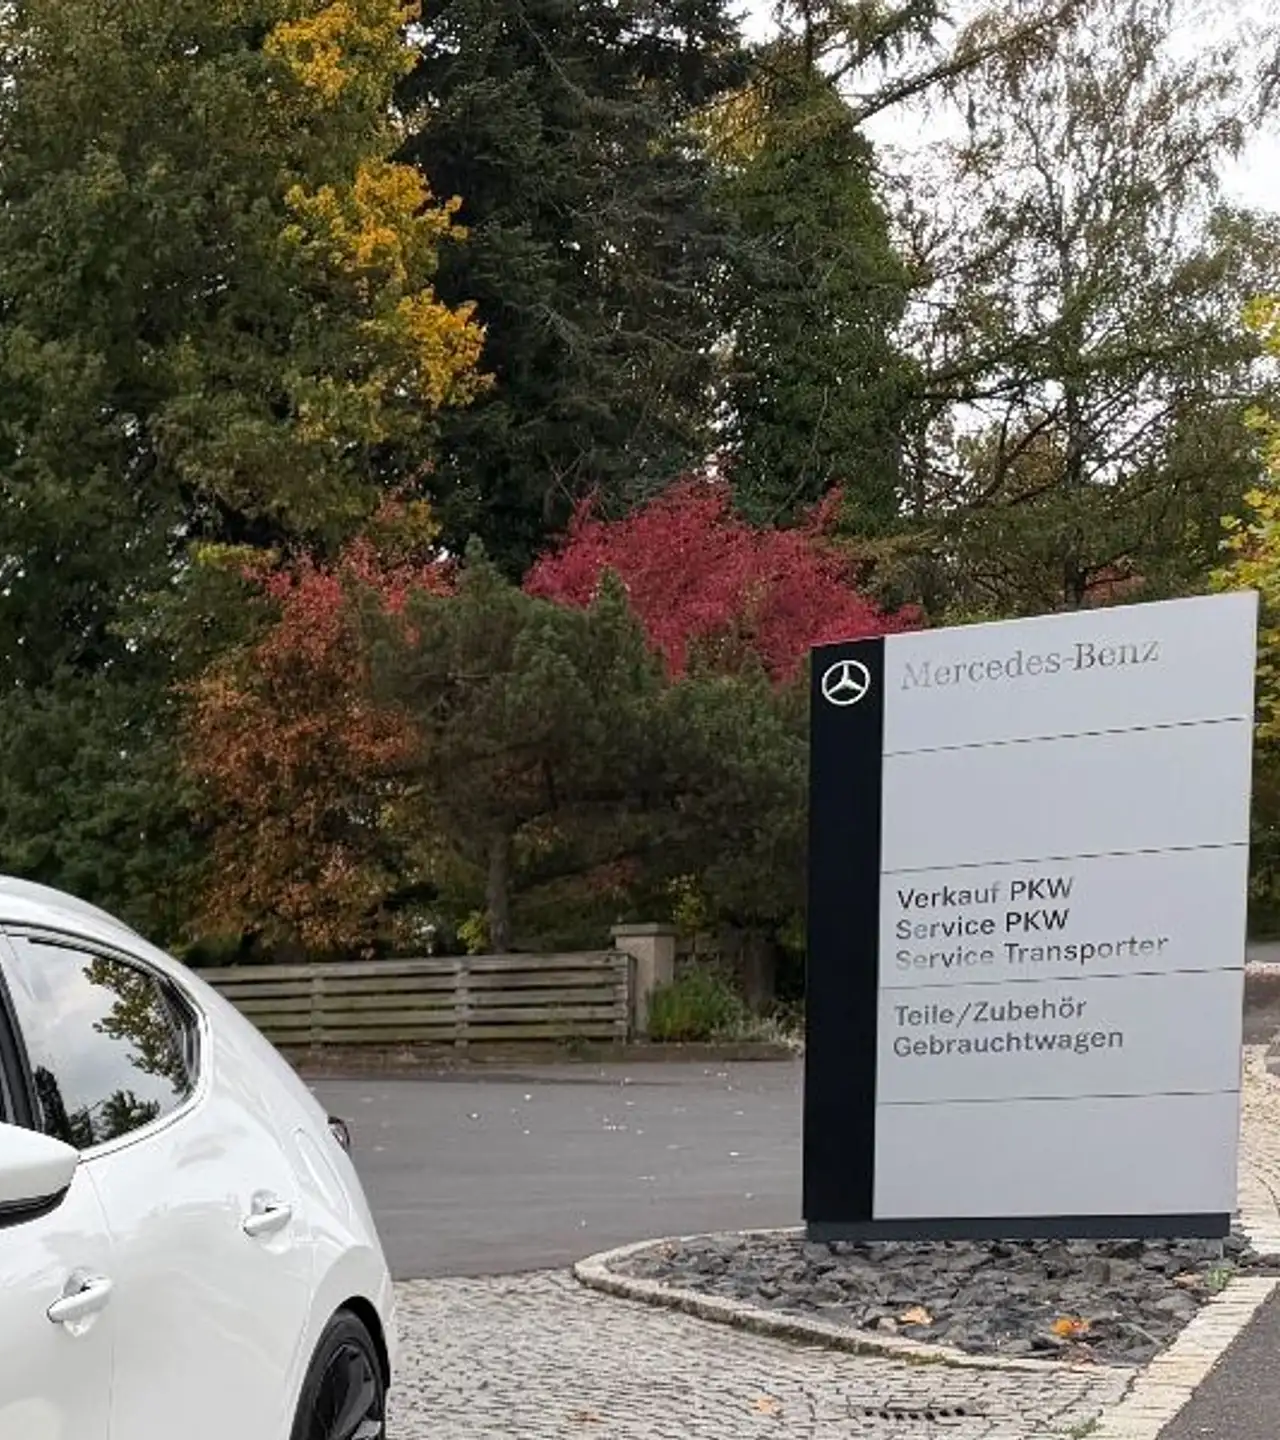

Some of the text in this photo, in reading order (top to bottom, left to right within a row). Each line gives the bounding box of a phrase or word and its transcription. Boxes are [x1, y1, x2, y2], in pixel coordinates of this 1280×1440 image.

[900, 640, 1160, 691] Mercedes-Benz
[896, 875, 1075, 910] Verkauf PKW
[895, 908, 1070, 940] Service PKW
[895, 935, 1170, 970] Service Transporter
[893, 996, 1088, 1028] Teile/Zubehör
[893, 1030, 1125, 1059] Gebrauchtwagen
